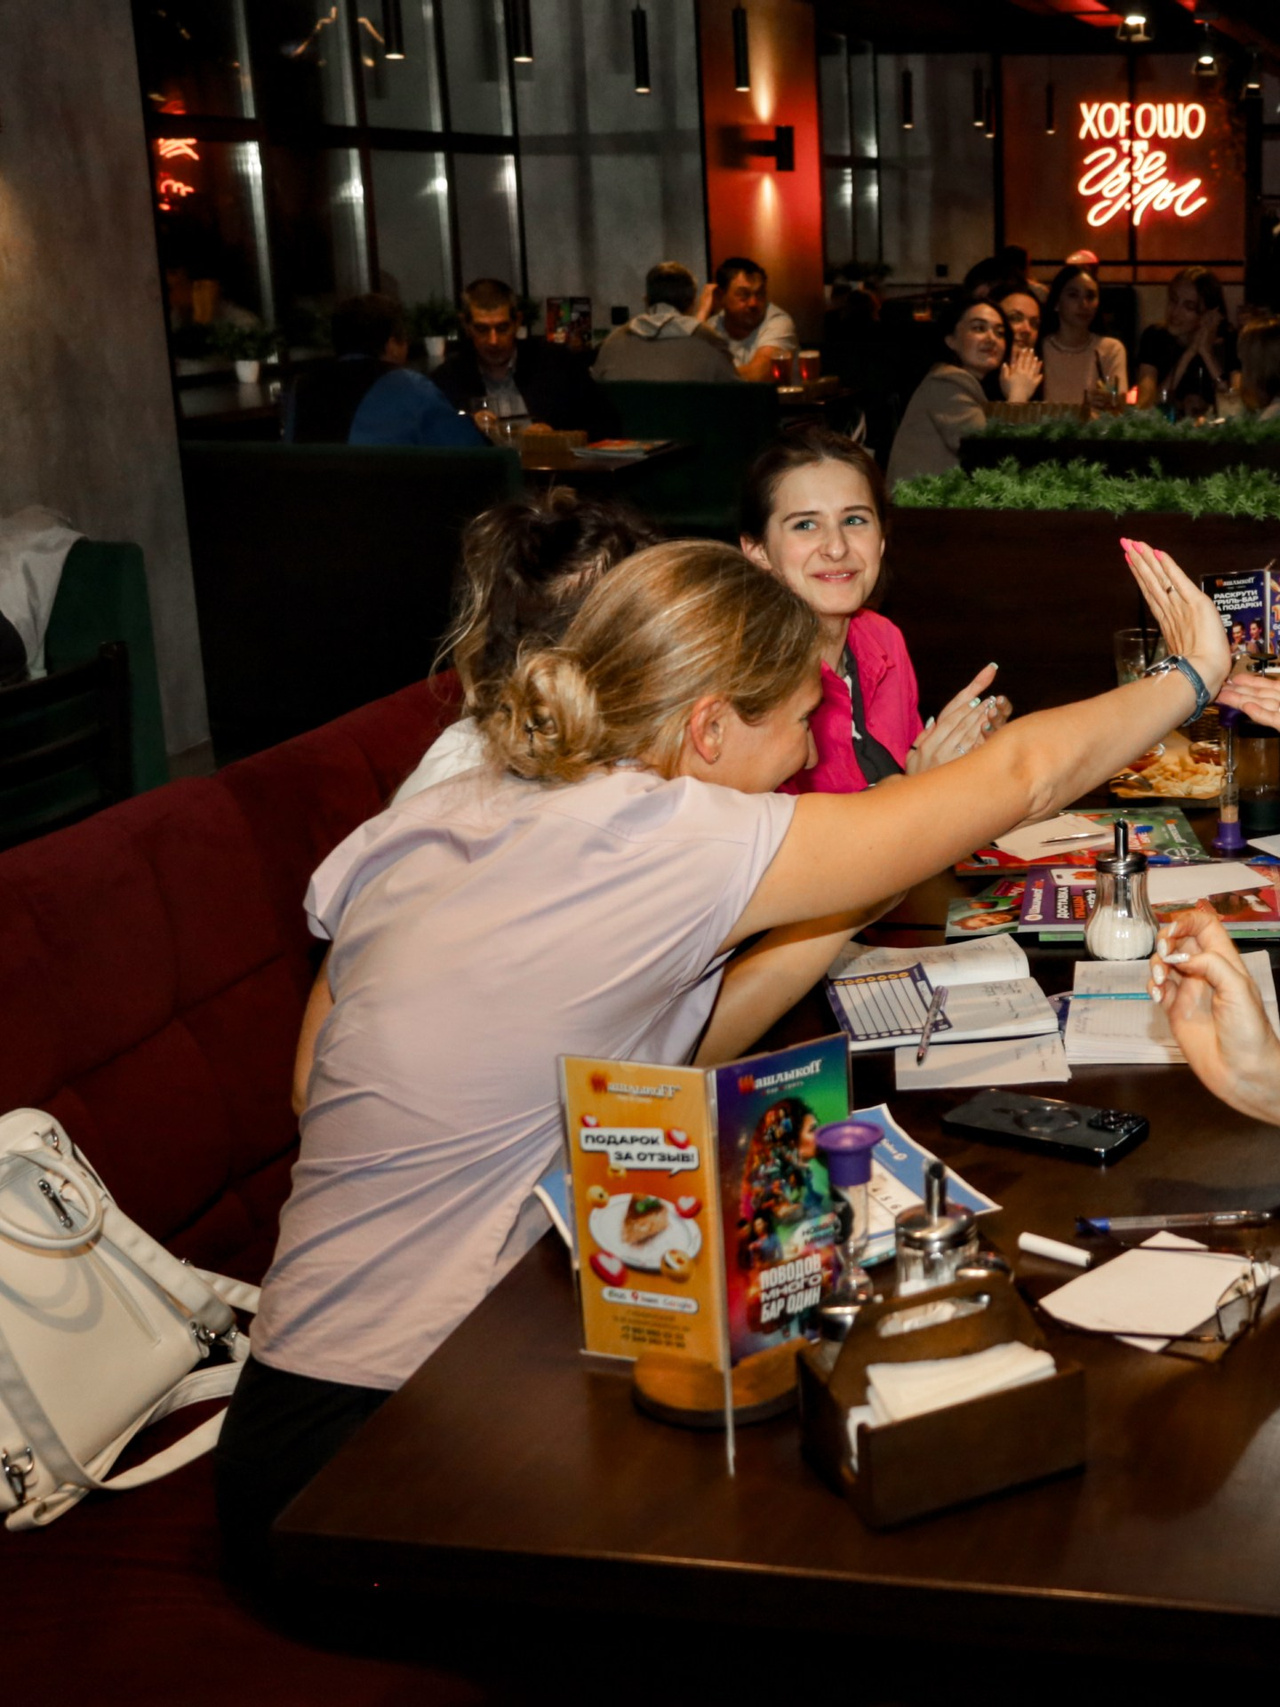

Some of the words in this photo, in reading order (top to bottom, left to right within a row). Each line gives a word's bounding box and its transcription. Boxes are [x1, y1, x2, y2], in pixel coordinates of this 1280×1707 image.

[1079, 102, 1206, 140] ХОРОШО
[1213, 590, 1258, 600] РАСКРУТИ
[1222, 601, 1262, 611] ПОДАРКИ
[1056, 886, 1070, 919] ДОСТАВКА
[584, 1134, 660, 1146] ПОДАРОК
[614, 1151, 634, 1161] ЗА
[636, 1151, 695, 1163] ОТЗЫВ!
[760, 1253, 822, 1290] ПОВОДОВ
[761, 1274, 822, 1303] МНОГО
[761, 1298, 785, 1324] БАР
[786, 1286, 821, 1314] ОДИН
